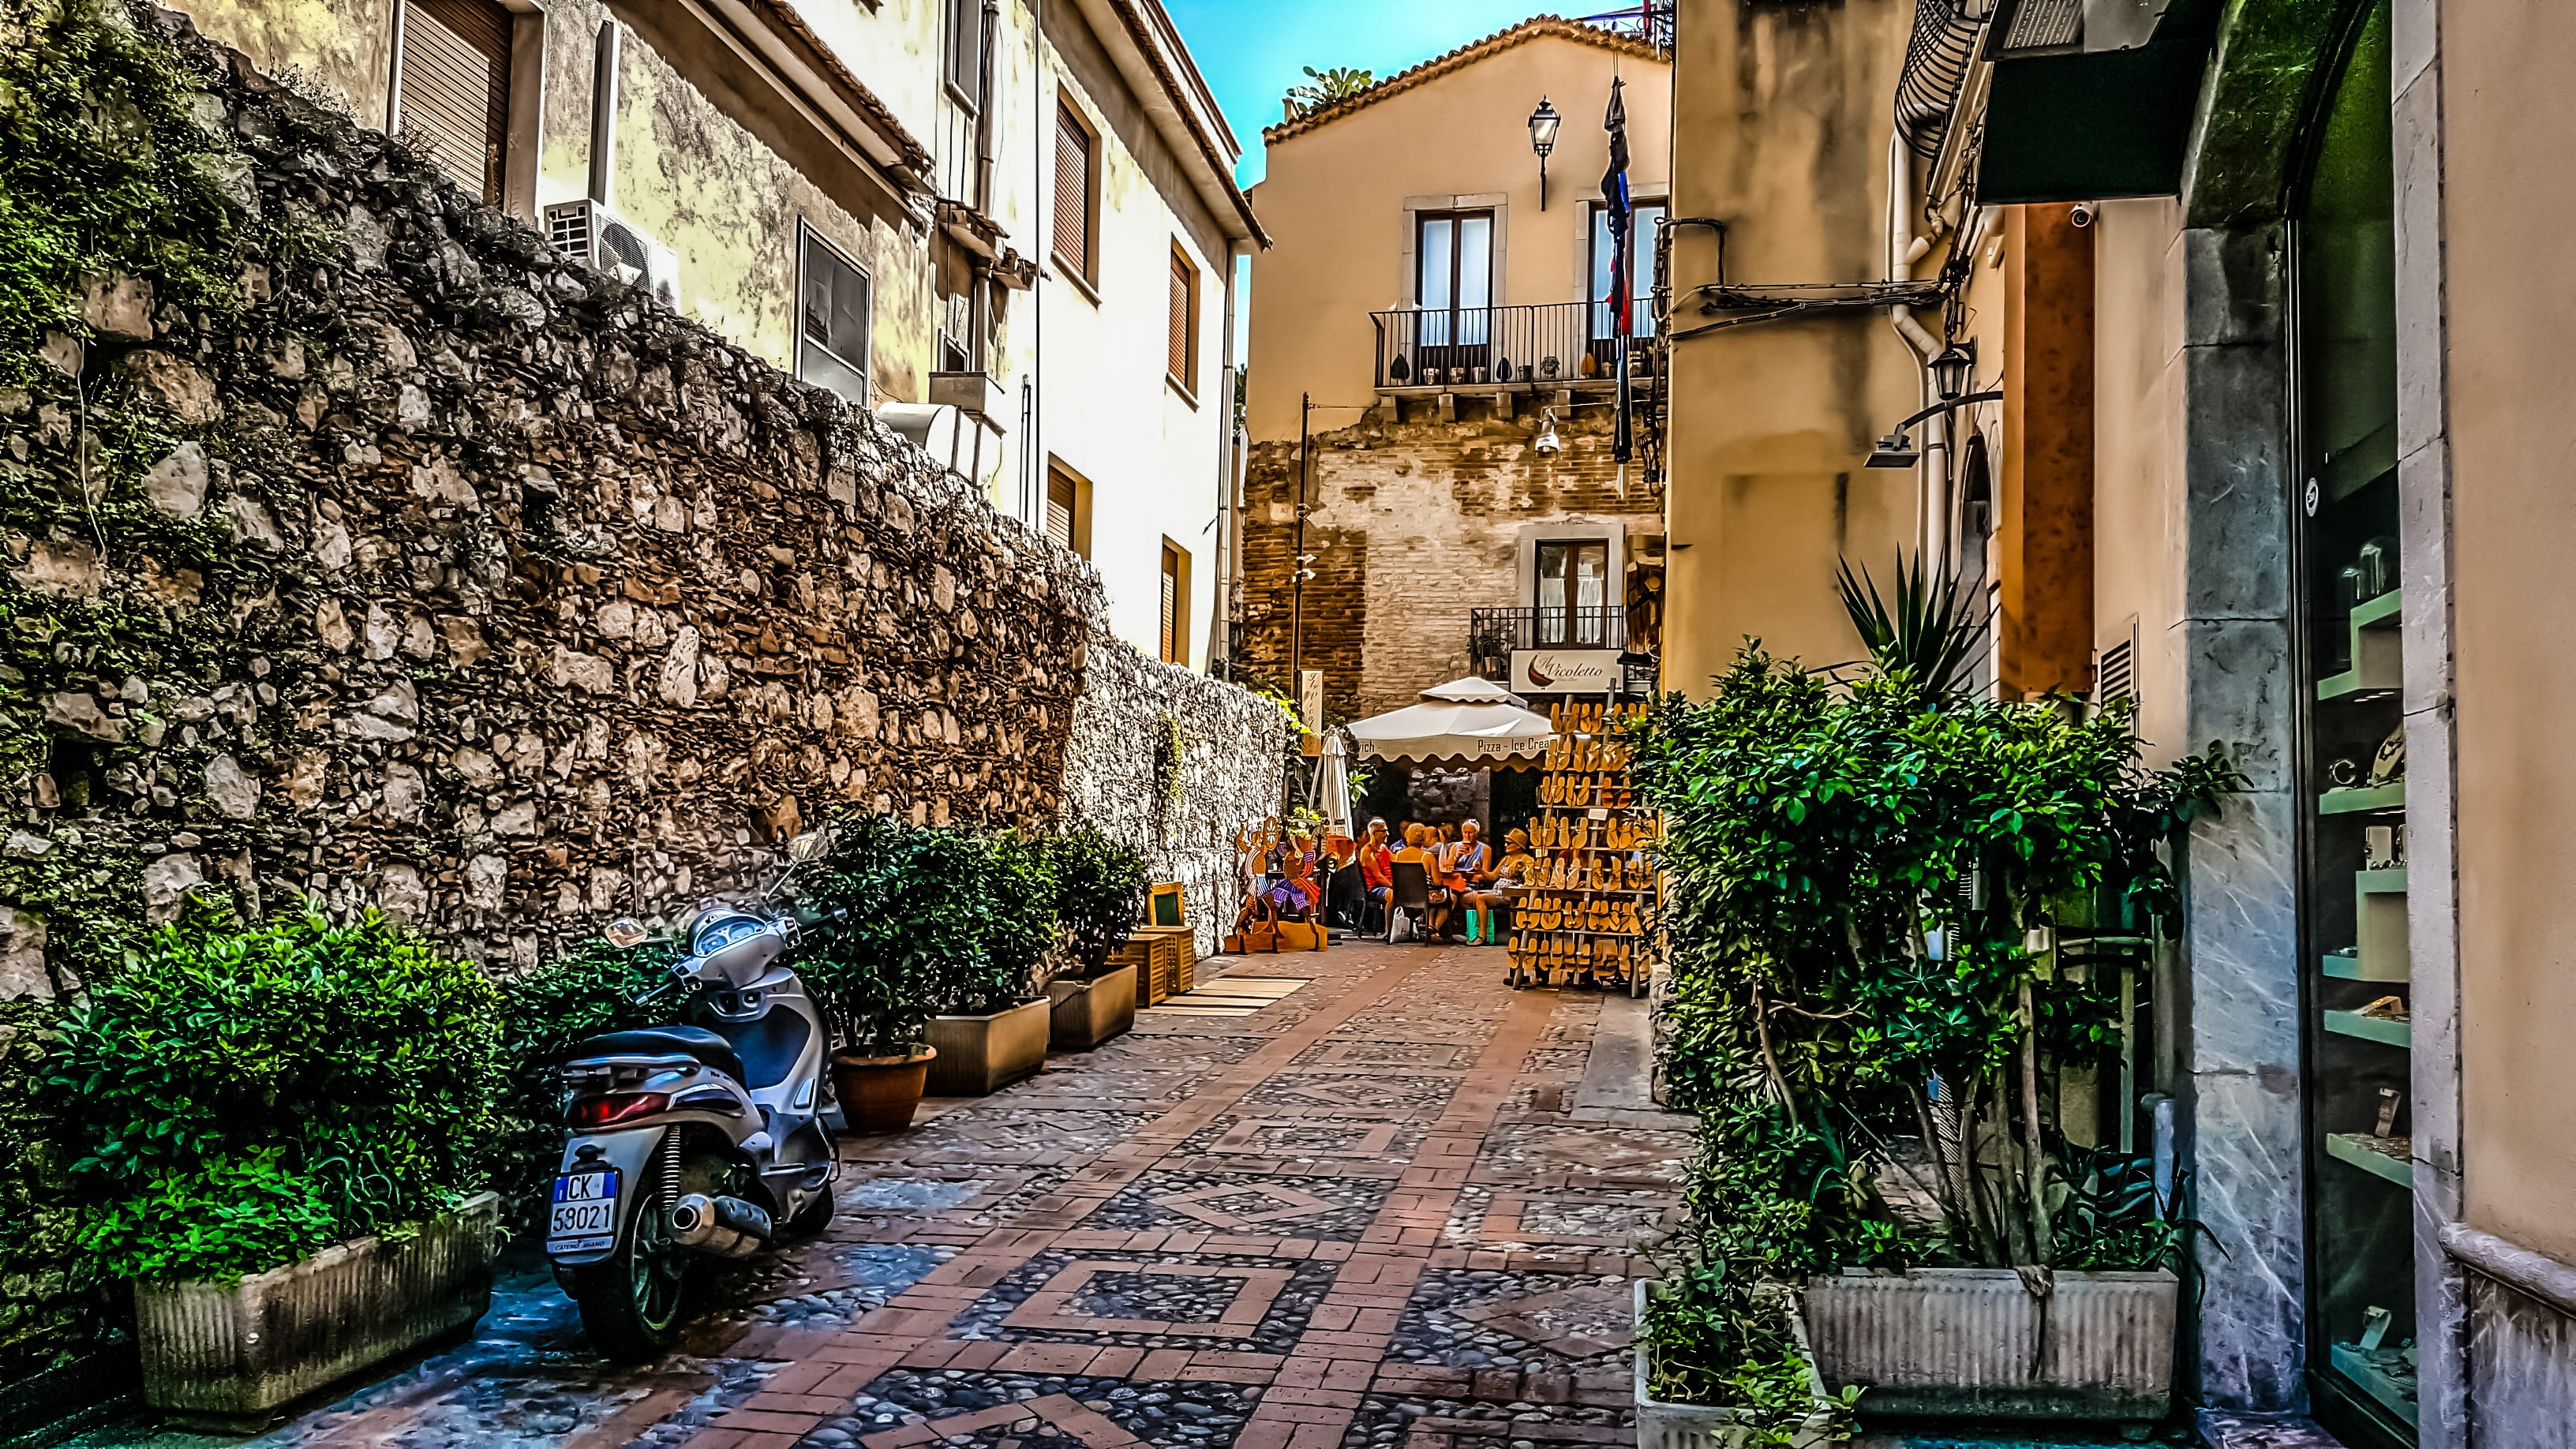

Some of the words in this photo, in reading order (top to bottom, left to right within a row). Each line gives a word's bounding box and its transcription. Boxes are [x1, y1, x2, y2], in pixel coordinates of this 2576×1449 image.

[1538, 655, 1555, 670] Il
[1545, 662, 1603, 677] Vicoletto
[1477, 739, 1501, 752] Pizza
[1511, 738, 1525, 751] Ice
[1528, 737, 1557, 750] Crea
[569, 1174, 593, 1200] CK
